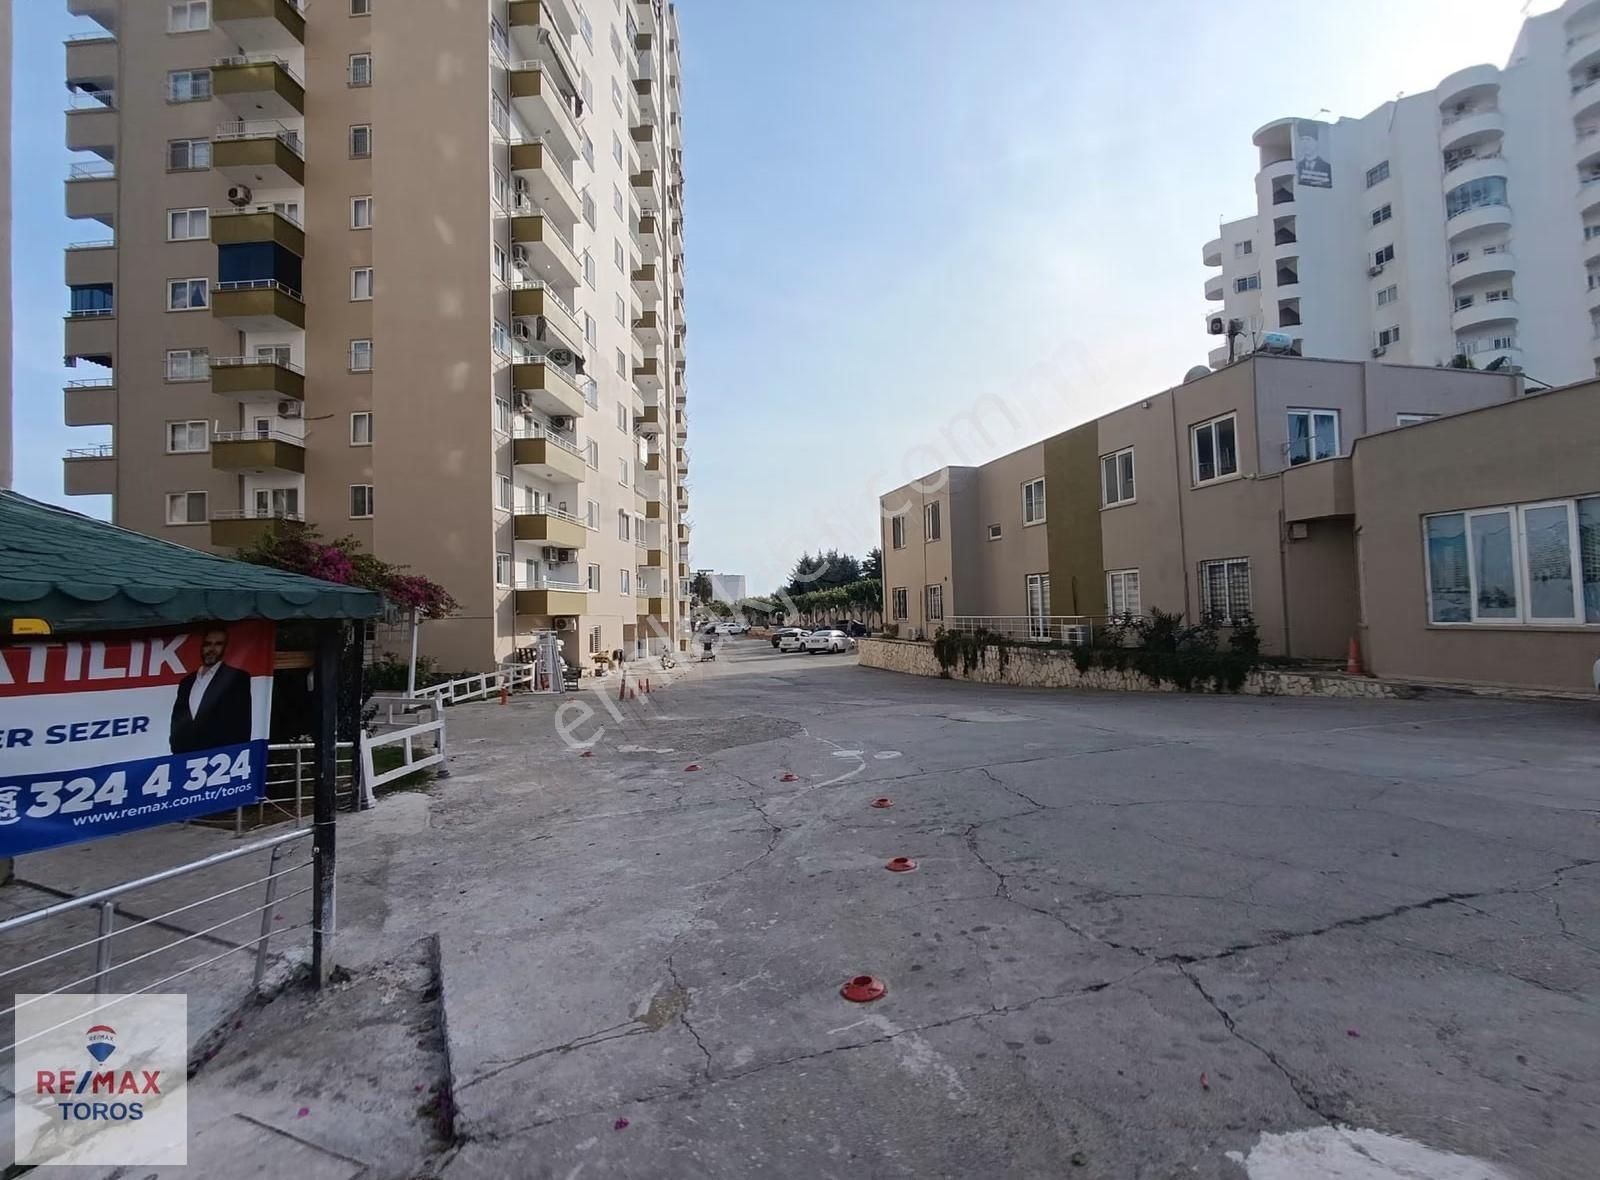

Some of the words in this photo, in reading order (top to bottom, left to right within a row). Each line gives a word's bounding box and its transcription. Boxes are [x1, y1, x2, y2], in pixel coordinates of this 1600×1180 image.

[0, 728, 34, 748] R
[45, 716, 150, 744] SEZER
[25, 771, 128, 818] 324
[142, 764, 171, 797] 4
[183, 749, 251, 791] 324
[73, 783, 252, 826] www.remax.com.tr/toros
